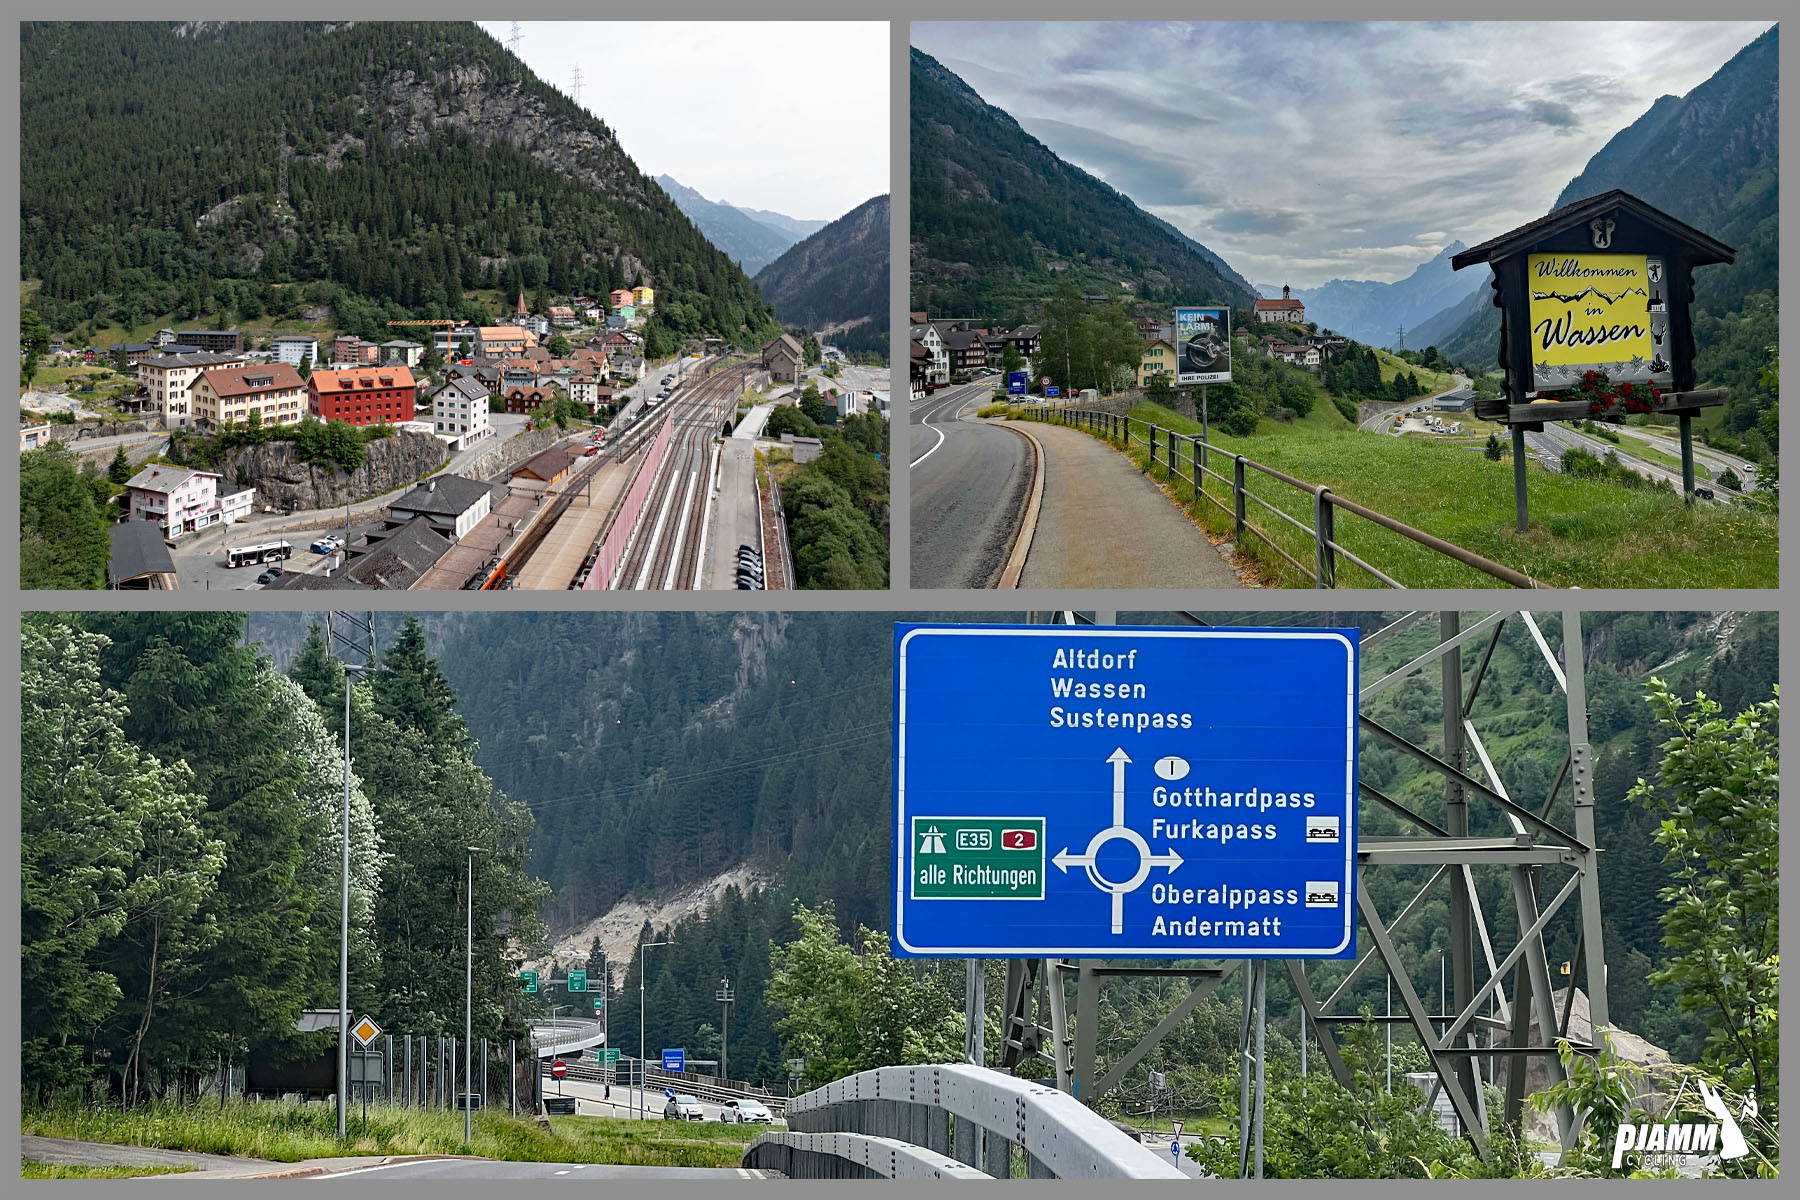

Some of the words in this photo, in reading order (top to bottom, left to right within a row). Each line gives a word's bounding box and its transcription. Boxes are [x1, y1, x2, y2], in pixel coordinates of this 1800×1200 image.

[1534, 258, 1638, 278] Willkommen
[1180, 313, 1205, 321] KEIN
[1584, 303, 1604, 317] in
[1180, 321, 1214, 331] LÄRM!
[1534, 310, 1645, 351] Wassen
[1196, 373, 1219, 381] POLIZEI
[1052, 648, 1138, 670] Altdorf
[1050, 677, 1147, 699] Wassen
[1049, 706, 1193, 734] Sustenpass
[1152, 786, 1316, 813] Gotthardpass
[959, 832, 989, 848] E35
[1014, 832, 1025, 848] 2
[1152, 818, 1277, 845] Furkapass
[919, 864, 947, 886] alle
[952, 864, 1037, 891] Richtungen
[1151, 883, 1299, 911] Oberalppass
[1151, 915, 1282, 938] Andermatt
